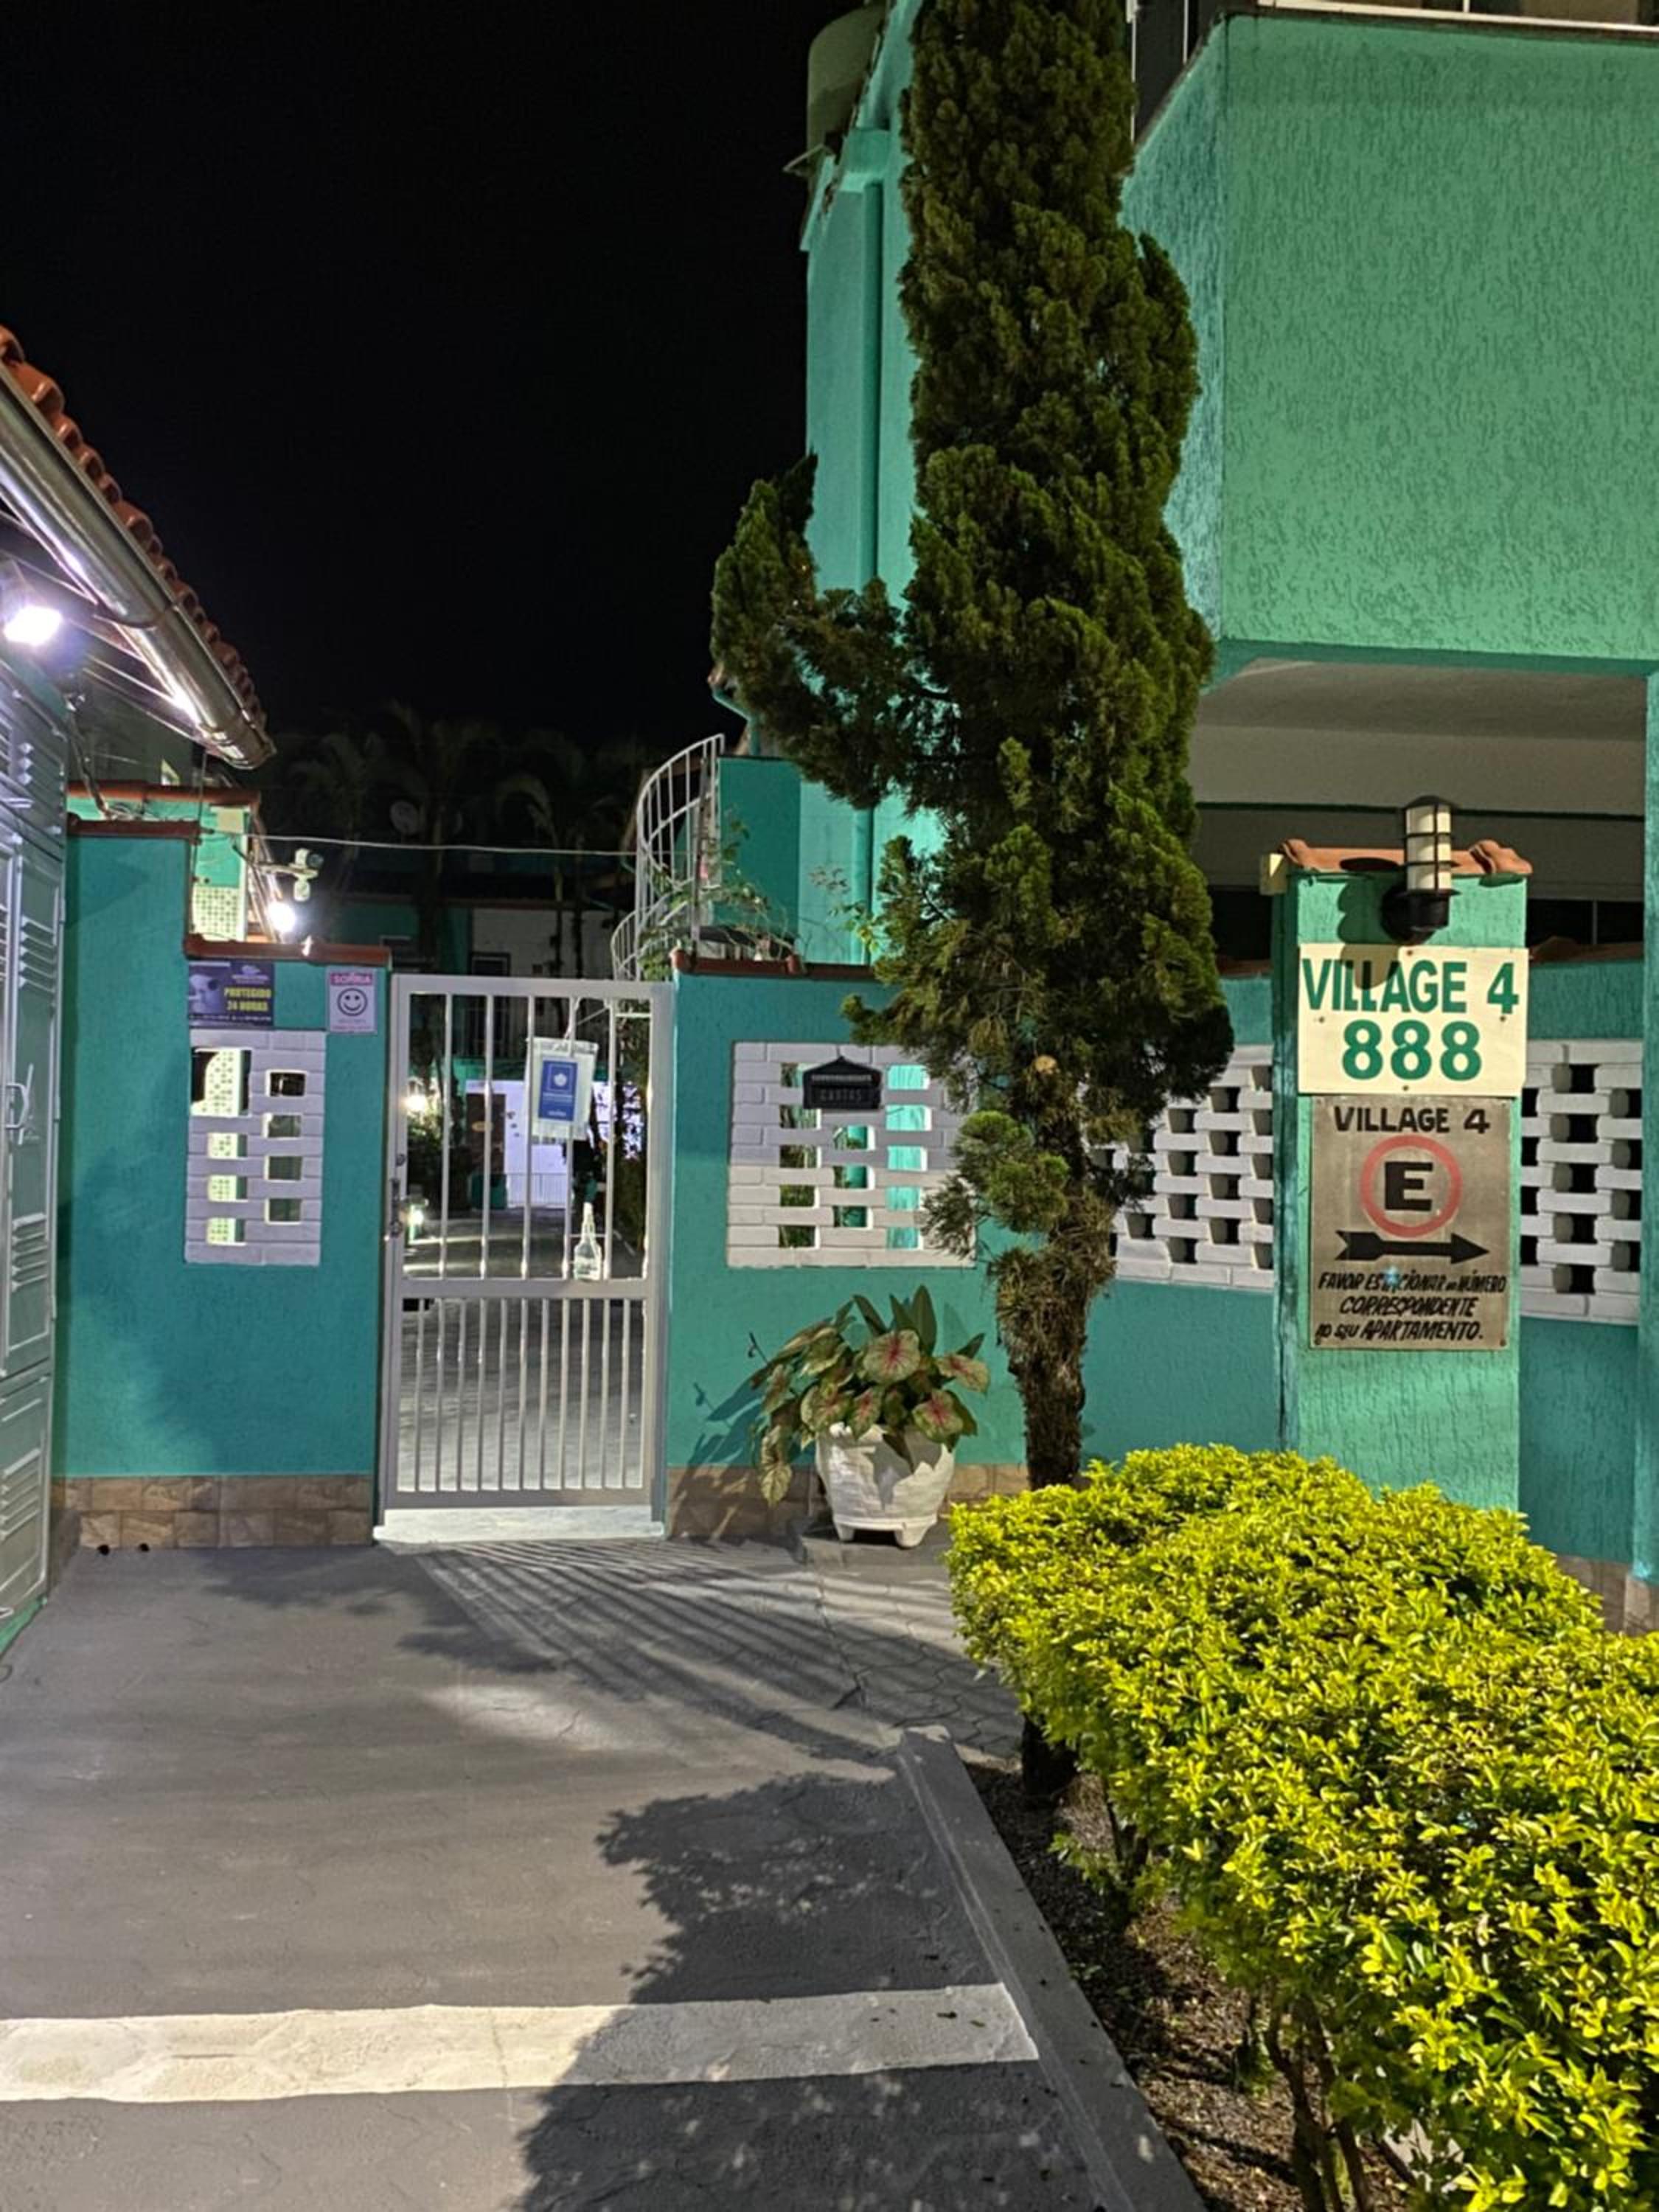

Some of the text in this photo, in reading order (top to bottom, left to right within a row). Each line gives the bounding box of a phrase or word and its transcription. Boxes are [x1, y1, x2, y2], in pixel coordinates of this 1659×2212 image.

[1302, 959, 1519, 1015] VILLAGE 4
[1342, 1019, 1482, 1082] 888
[1334, 1106, 1490, 1134] VILLAGE 4
[1384, 1161, 1433, 1211] E
[1318, 1272, 1365, 1290] FAVOR
[1339, 1295, 1479, 1317] CORRESPONDENTE
